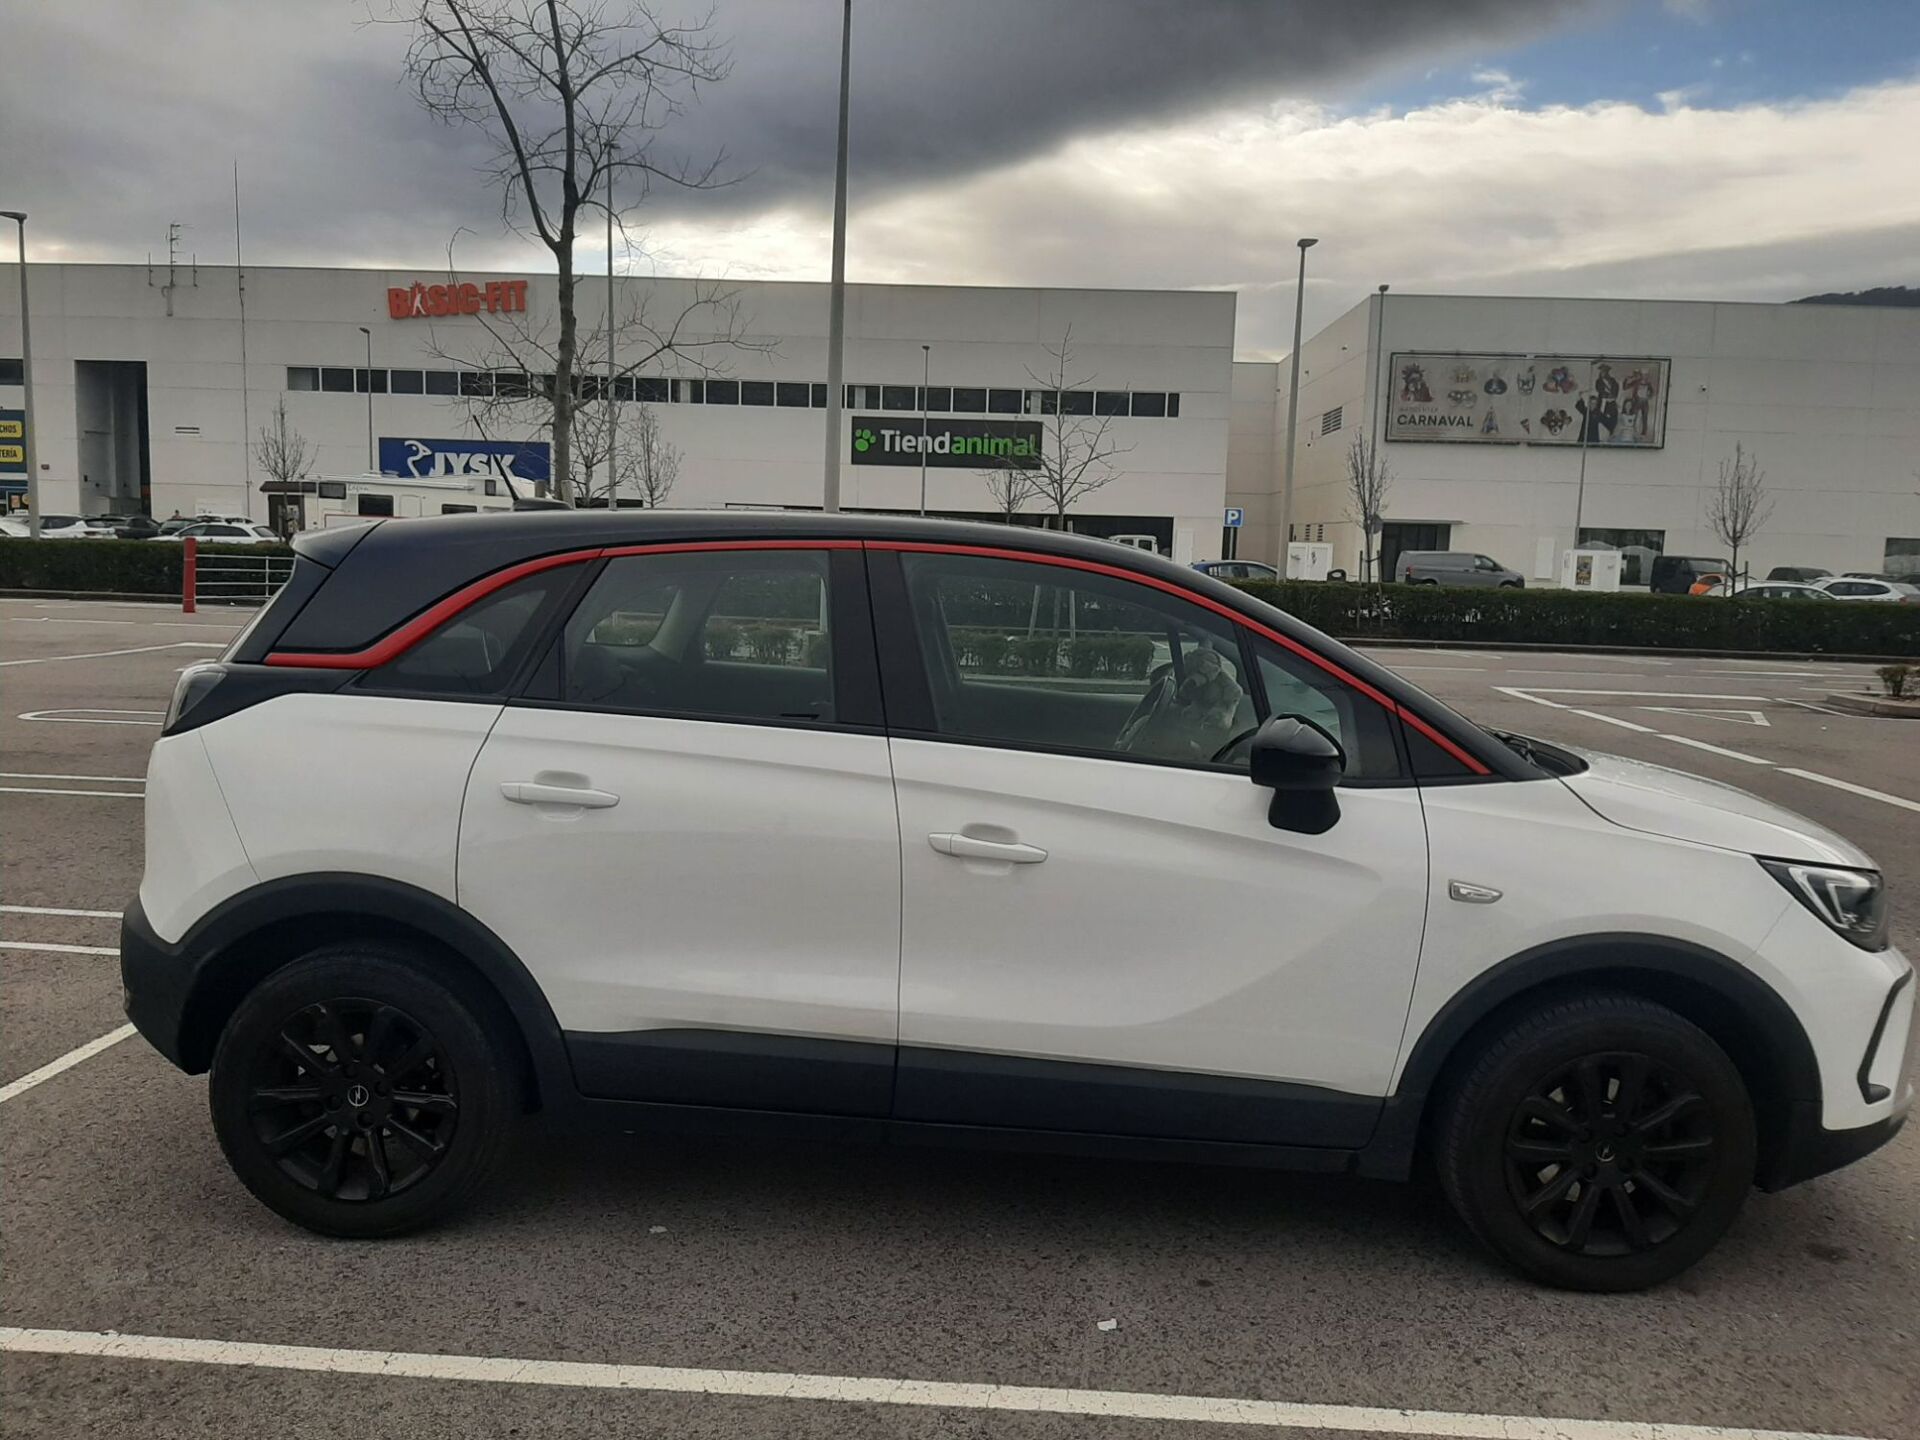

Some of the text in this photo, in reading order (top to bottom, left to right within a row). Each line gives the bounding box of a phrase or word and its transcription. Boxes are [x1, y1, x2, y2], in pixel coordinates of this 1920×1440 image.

[387, 280, 528, 319] BASIC-FIT
[1397, 414, 1474, 427] CARNAVAL
[880, 429, 1036, 456] Tiendanimal
[428, 452, 516, 477] JYSK
[1227, 510, 1239, 525] P
